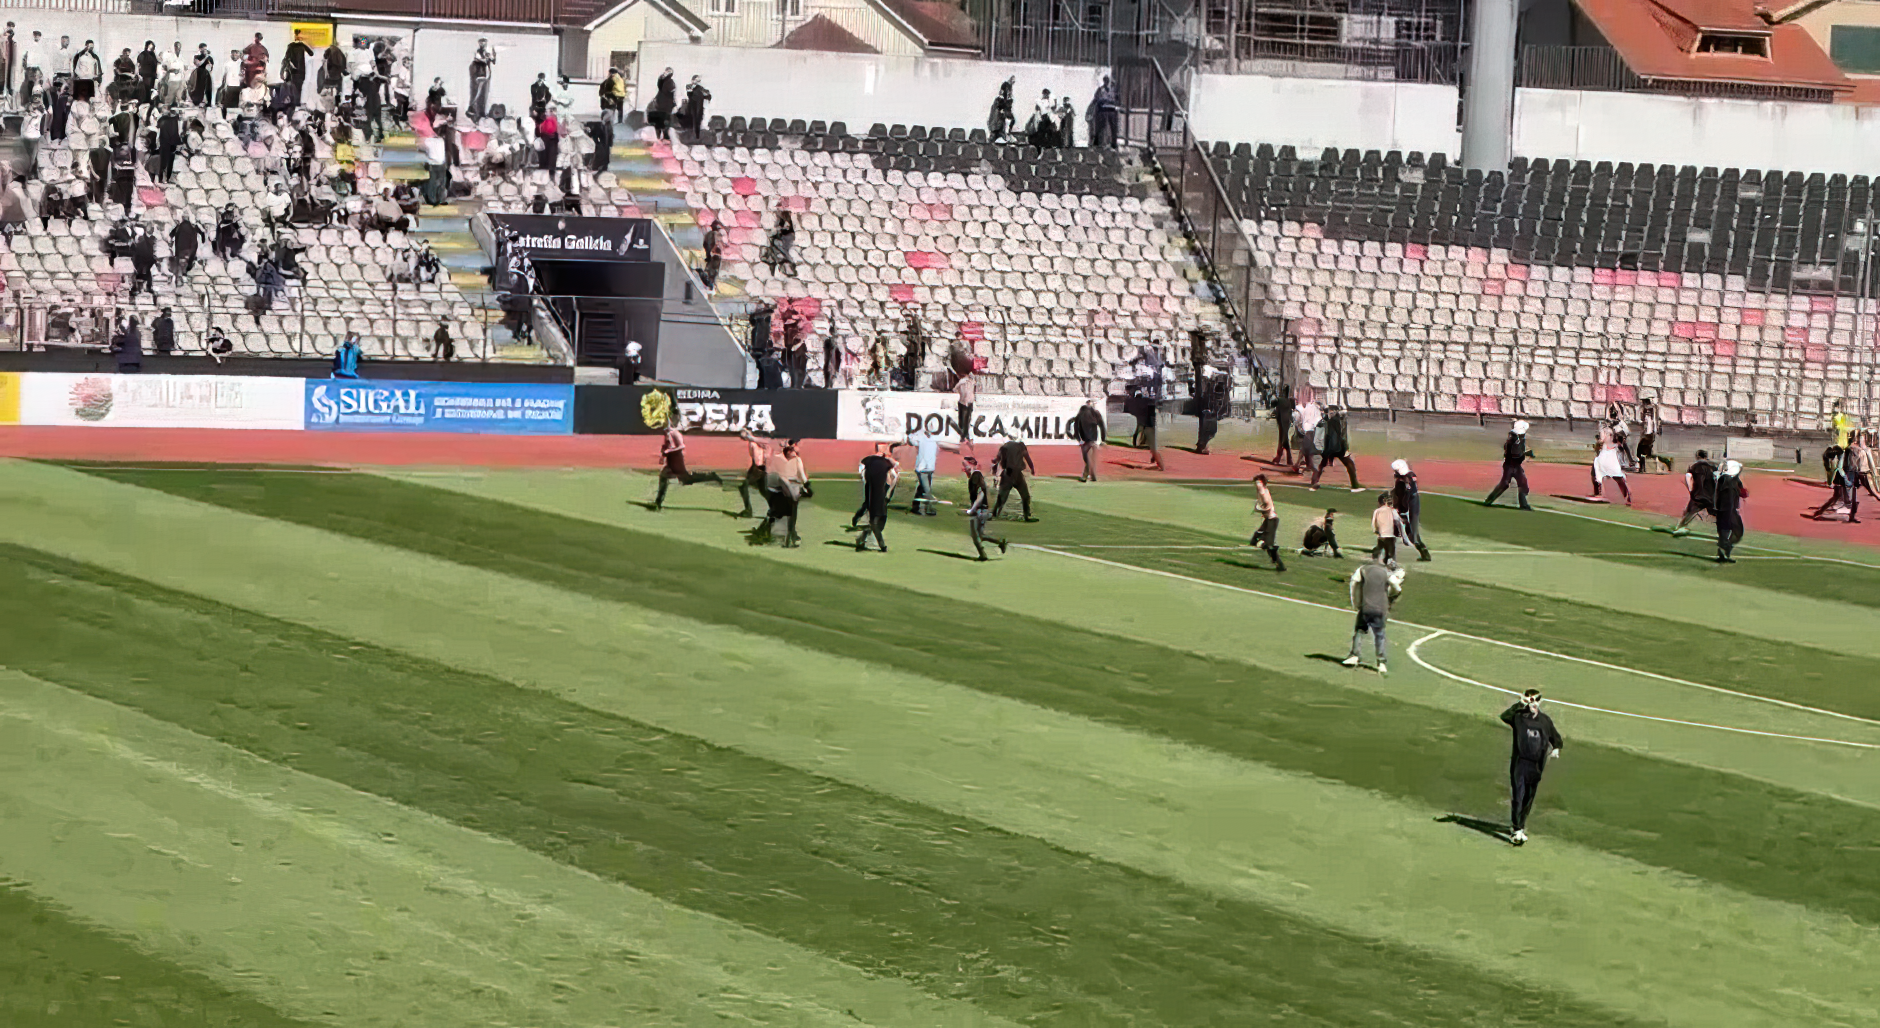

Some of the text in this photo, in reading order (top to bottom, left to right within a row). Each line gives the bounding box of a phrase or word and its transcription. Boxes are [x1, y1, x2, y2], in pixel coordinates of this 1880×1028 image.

[512, 234, 612, 251] strella Galicia
[339, 388, 425, 414] SIGAL
[677, 402, 776, 433] PEJA
